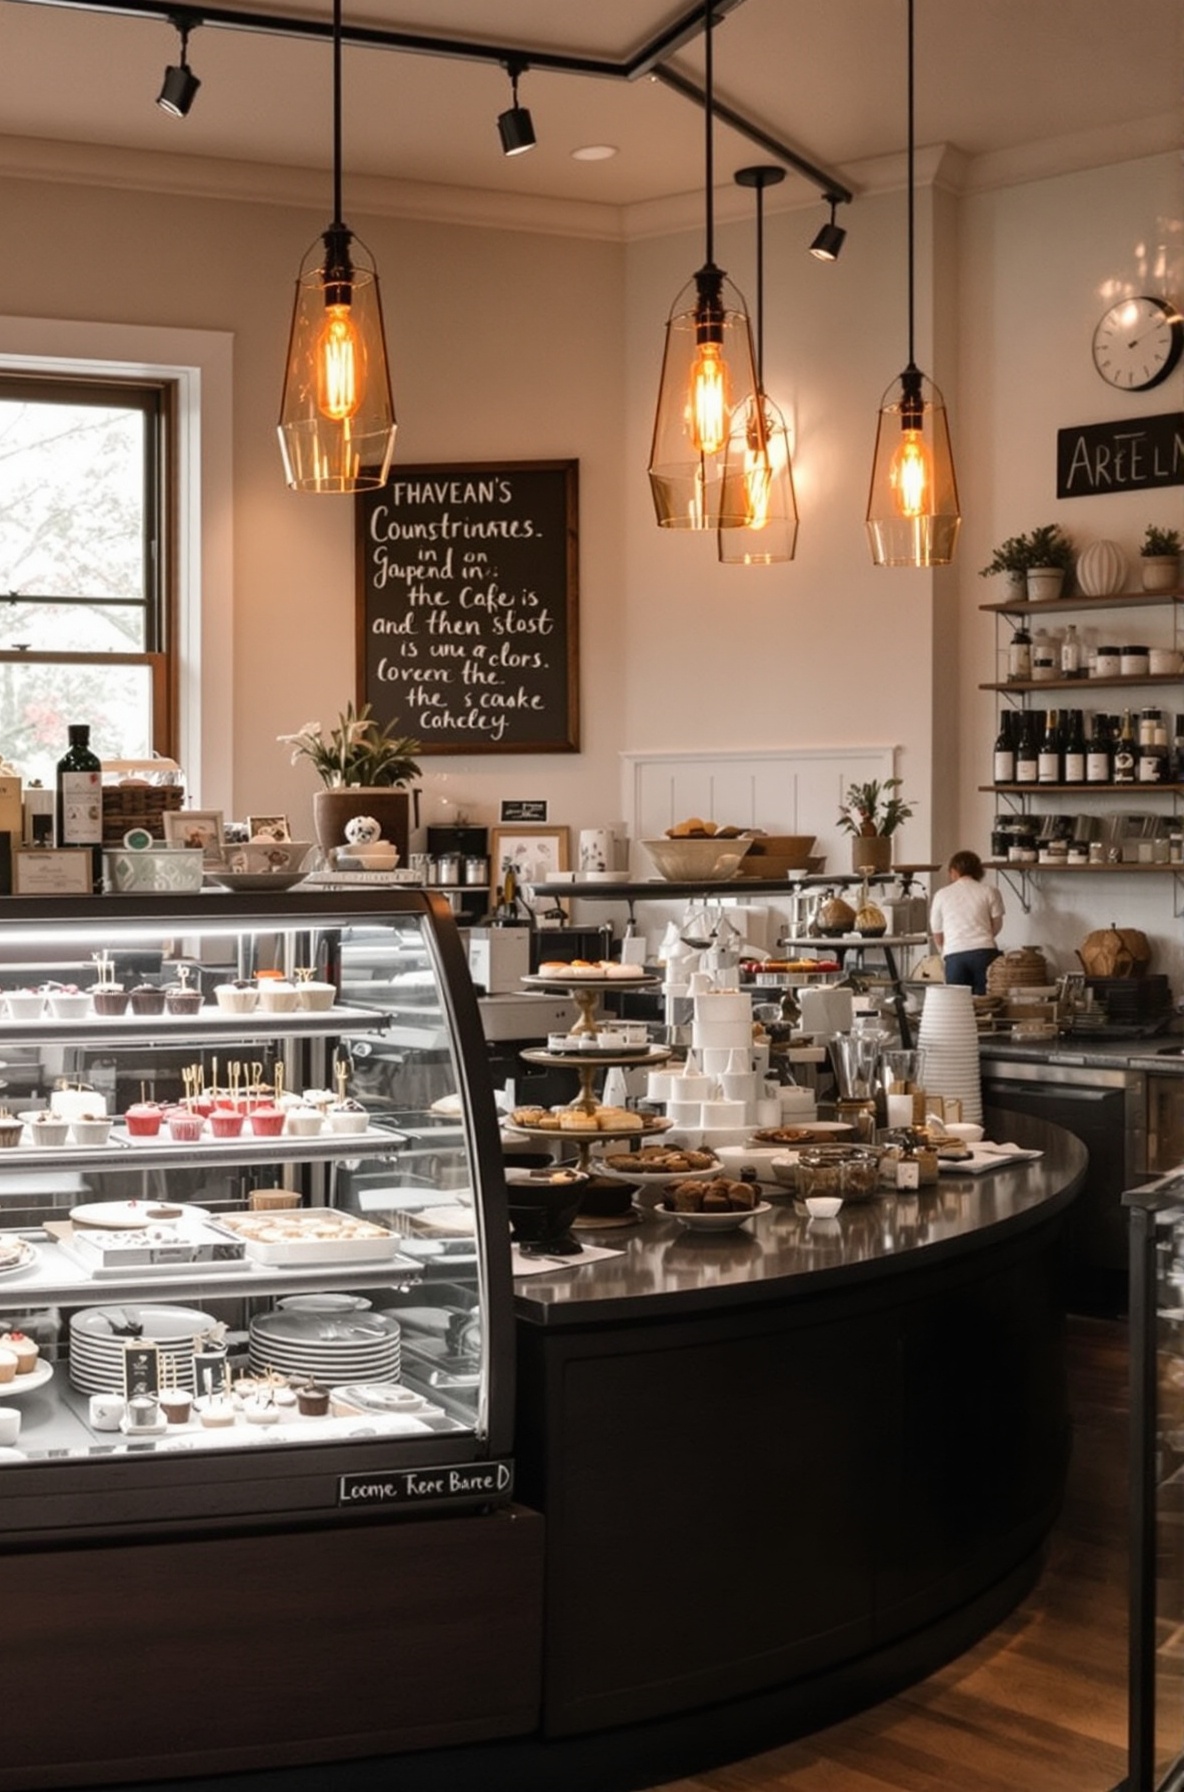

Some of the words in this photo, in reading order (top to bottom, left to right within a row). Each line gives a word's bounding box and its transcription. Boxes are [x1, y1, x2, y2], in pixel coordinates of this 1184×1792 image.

[521, 589, 539, 607] is
[372, 611, 418, 635] and
[426, 610, 481, 635] then
